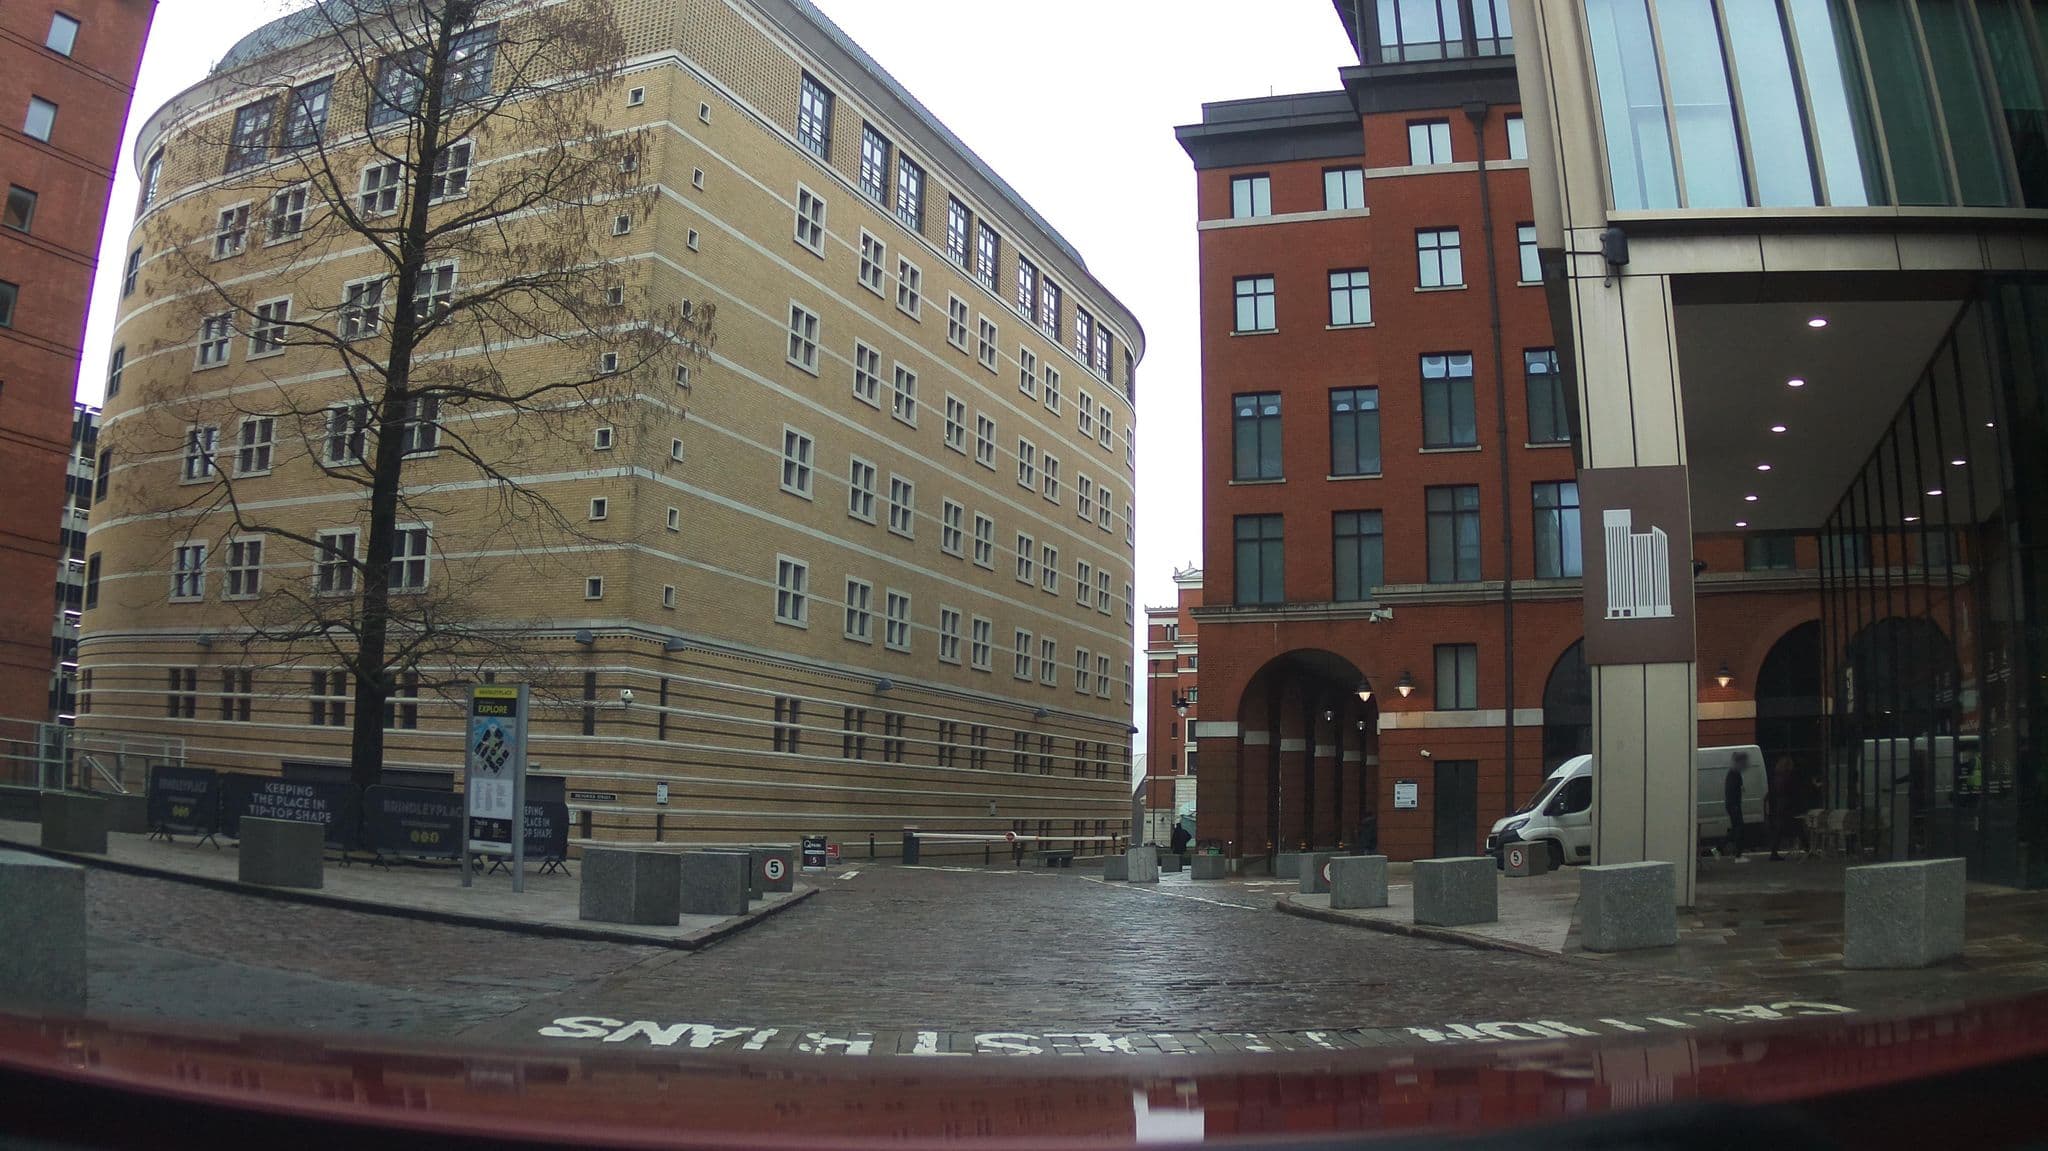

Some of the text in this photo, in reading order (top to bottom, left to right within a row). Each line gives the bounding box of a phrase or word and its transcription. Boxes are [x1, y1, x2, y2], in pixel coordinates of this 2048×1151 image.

[478, 704, 509, 714] EXPLORE
[264, 783, 314, 797] KEEPING
[253, 792, 326, 811] THE PLACE IN
[248, 804, 332, 824] TIP-TOP SHAPE
[383, 800, 464, 817] BRINDLEYPLAC
[524, 806, 544, 816] EPING
[1513, 852, 1520, 862] 5
[770, 861, 779, 874] 5
